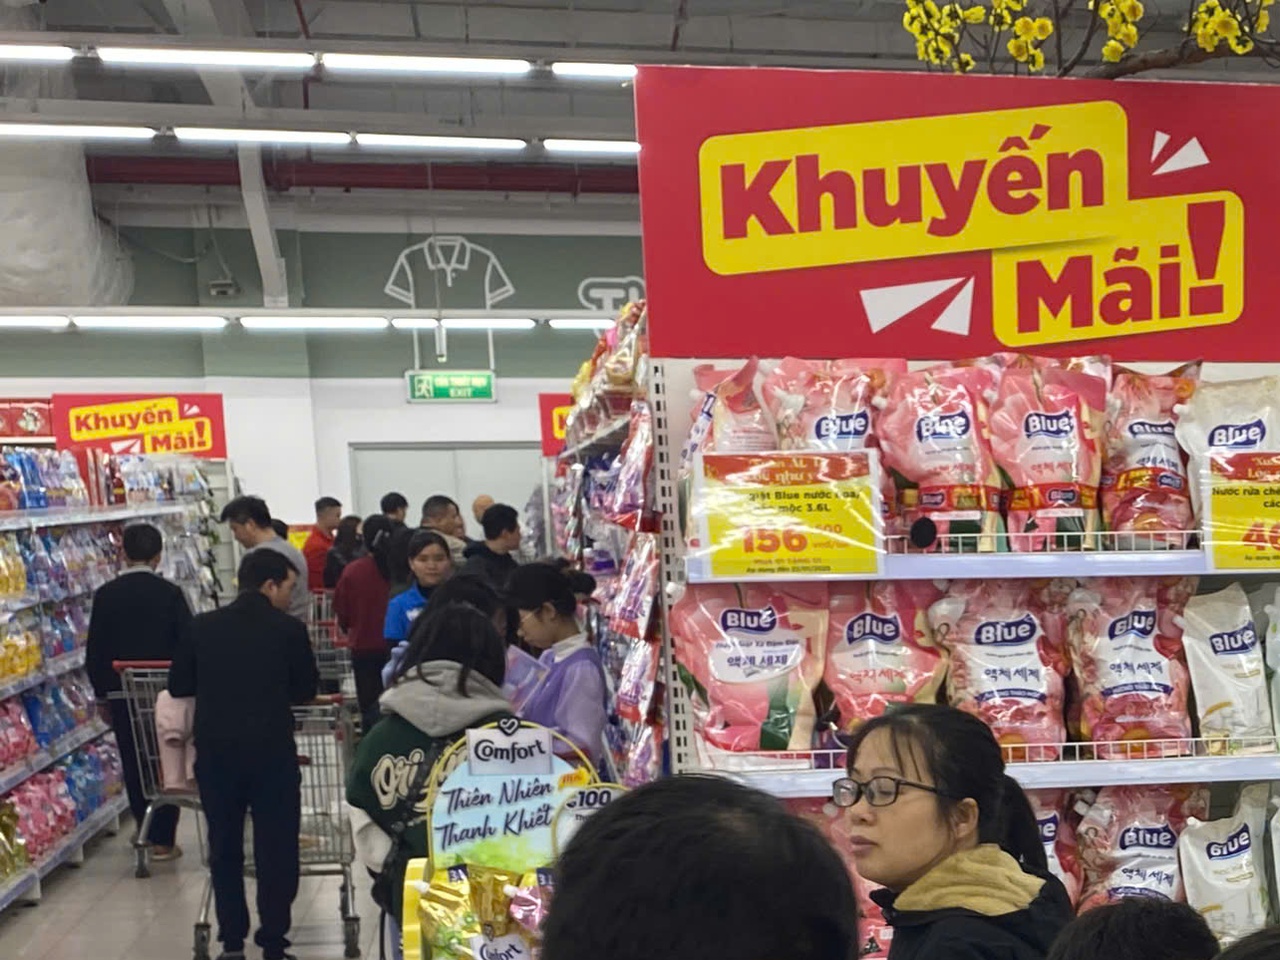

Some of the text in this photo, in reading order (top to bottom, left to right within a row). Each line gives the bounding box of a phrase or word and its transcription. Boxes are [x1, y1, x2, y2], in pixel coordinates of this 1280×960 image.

[720, 124, 1105, 240] Khuyến
[1015, 200, 1226, 335] Mãi!
[74, 403, 173, 431] Khuyến
[819, 412, 867, 436] Blue
[1028, 413, 1071, 433] Blue
[1132, 421, 1175, 436] Blue
[151, 421, 207, 452] Mãi!
[1213, 423, 1261, 447] Blue
[774, 490, 800, 500] Blue
[1263, 499, 1280, 508] các
[806, 503, 832, 512] 3.6L
[743, 525, 808, 554] 156
[726, 608, 774, 629] Blue
[853, 617, 897, 639] Blue
[1113, 614, 1155, 636] Blue
[980, 621, 1030, 643] Blue
[1213, 628, 1256, 651] Blue
[474, 738, 547, 764] Comfort
[440, 776, 555, 815] Thiên Nhiên
[434, 803, 555, 851] Thanh Khiết
[1124, 828, 1173, 847] Blue
[1210, 831, 1250, 857] Blue
